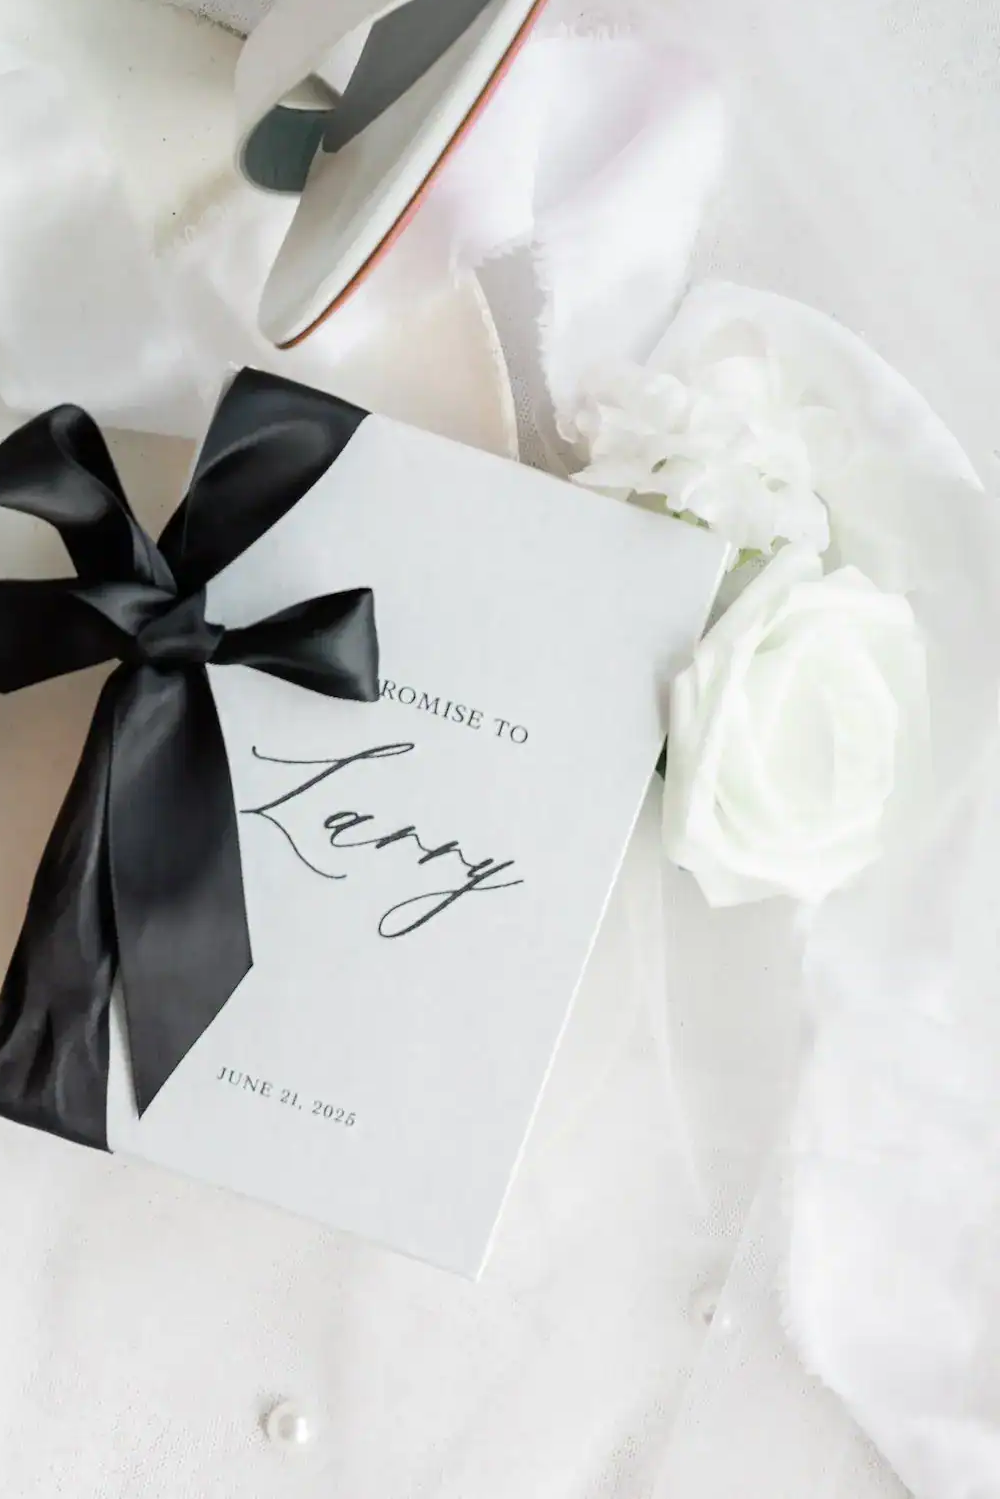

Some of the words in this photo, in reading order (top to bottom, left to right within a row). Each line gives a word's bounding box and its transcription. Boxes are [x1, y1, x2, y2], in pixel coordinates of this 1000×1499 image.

[377, 678, 484, 730] ROMISE
[493, 717, 529, 744] TO
[240, 742, 524, 938] Larry
[216, 1066, 274, 1098] JUNE
[280, 1088, 302, 1111] 21,
[311, 1099, 357, 1127] 2025
